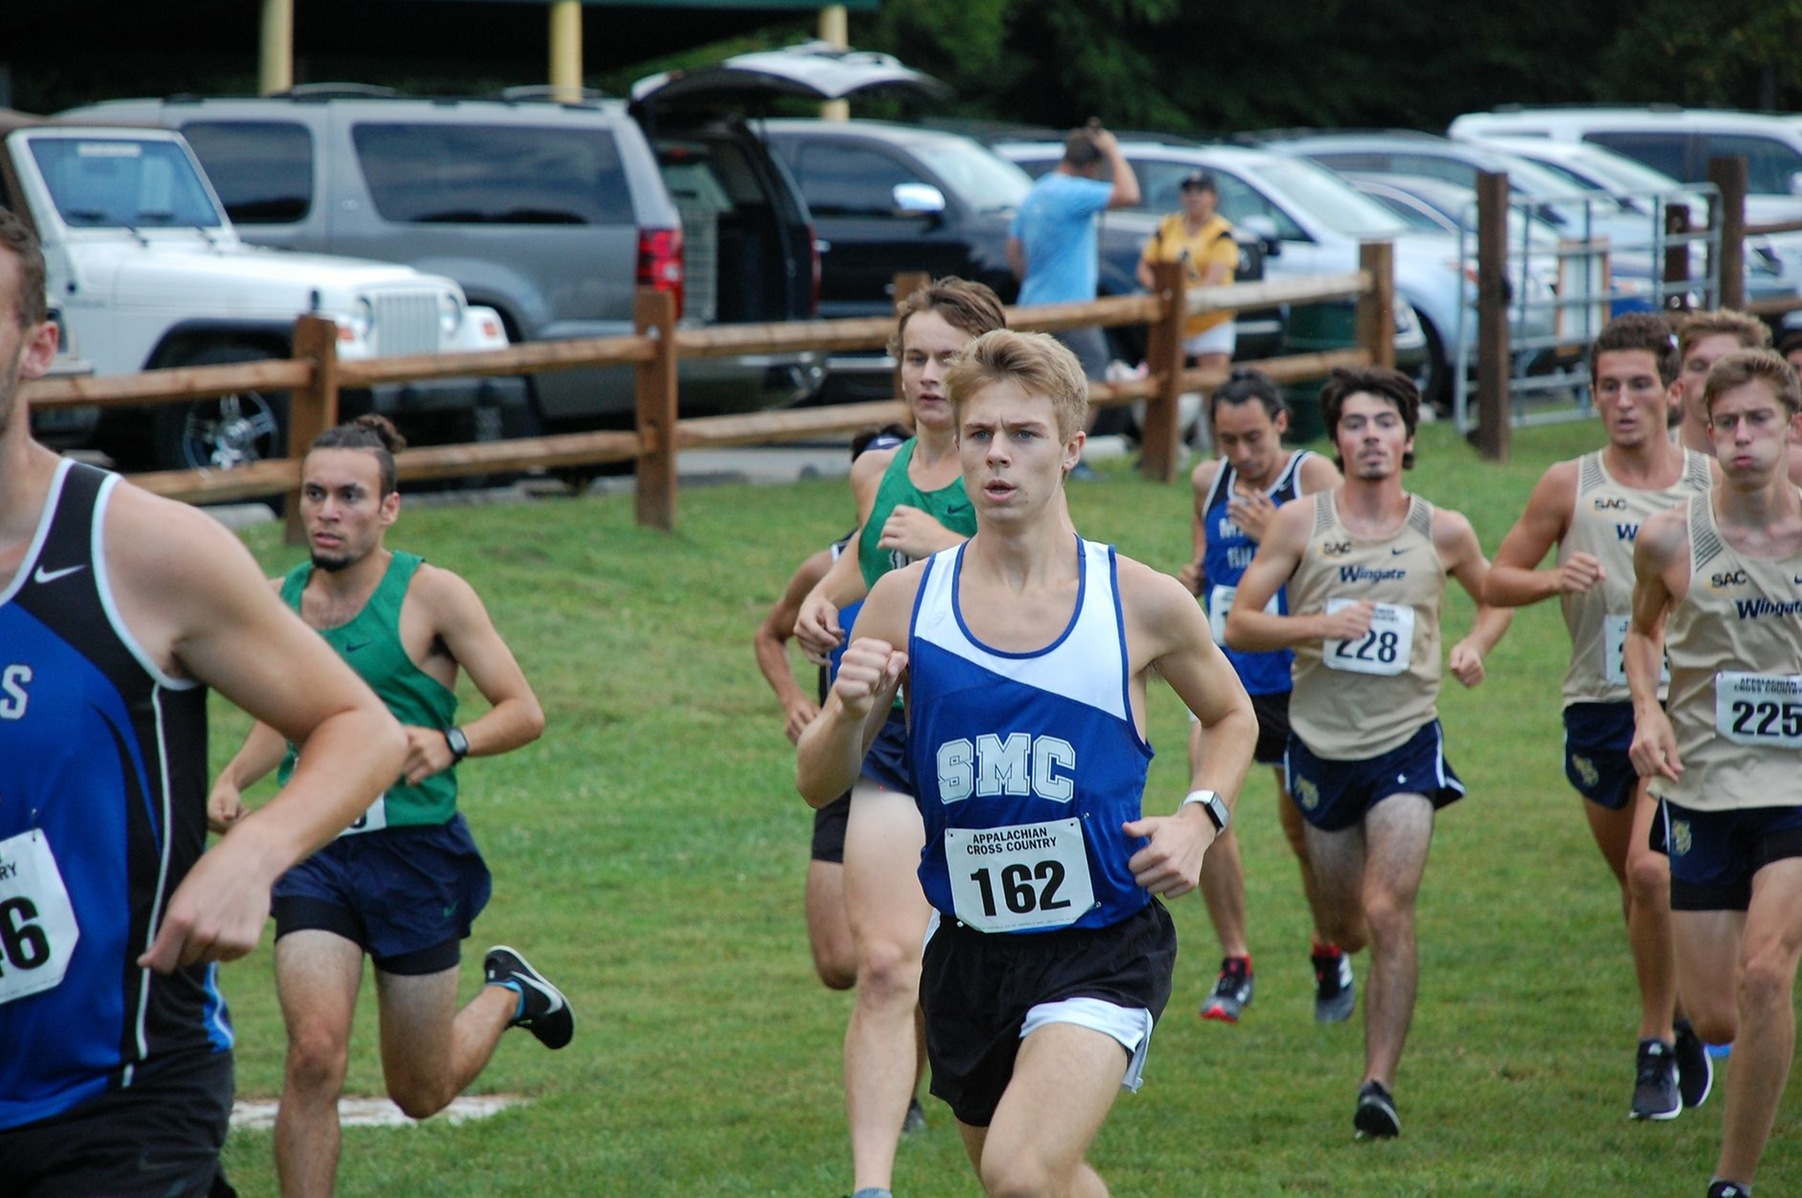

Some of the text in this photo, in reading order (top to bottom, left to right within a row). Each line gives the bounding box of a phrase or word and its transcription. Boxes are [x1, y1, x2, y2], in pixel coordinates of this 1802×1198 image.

[1340, 565, 1406, 585] Wingate
[1711, 569, 1747, 587] SAC
[1736, 597, 1802, 619] Wingat
[1335, 628, 1399, 664] 228
[1731, 700, 1802, 738] 225
[936, 732, 1077, 805] SMC
[966, 836, 1057, 856] CROSS COUNTRY
[972, 827, 1048, 845] APPALACHIAN
[970, 859, 1072, 917] 162
[0, 896, 51, 974] 6
